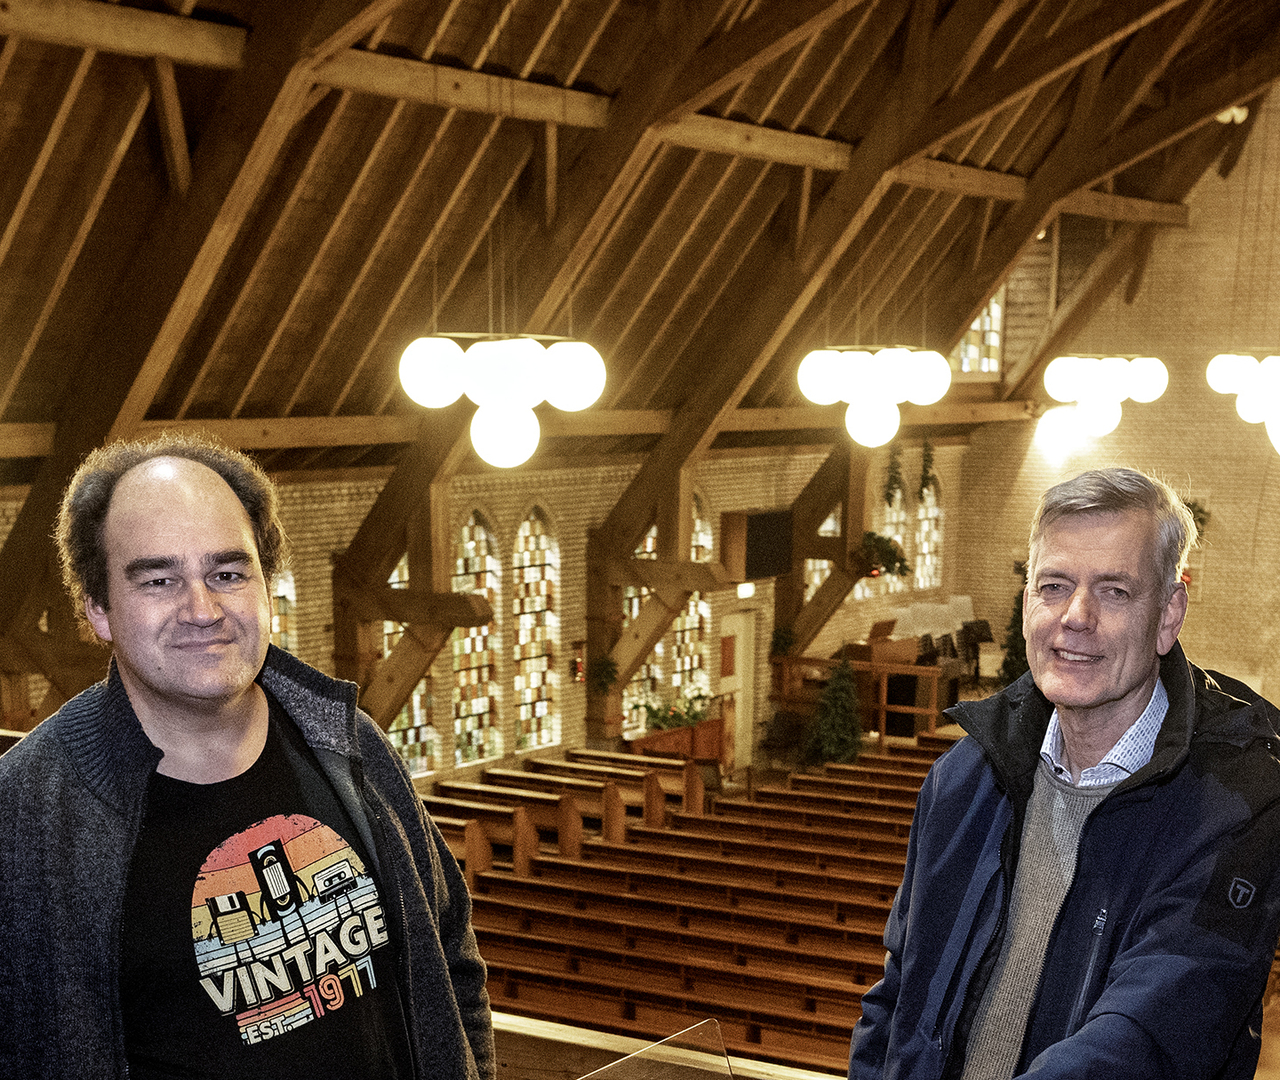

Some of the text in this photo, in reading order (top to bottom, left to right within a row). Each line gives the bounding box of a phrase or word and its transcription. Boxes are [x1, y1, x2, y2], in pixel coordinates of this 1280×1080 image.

[1235, 883, 1251, 904] T
[199, 905, 389, 1015] VINTAGE
[245, 954, 378, 1046] EST. 1977
